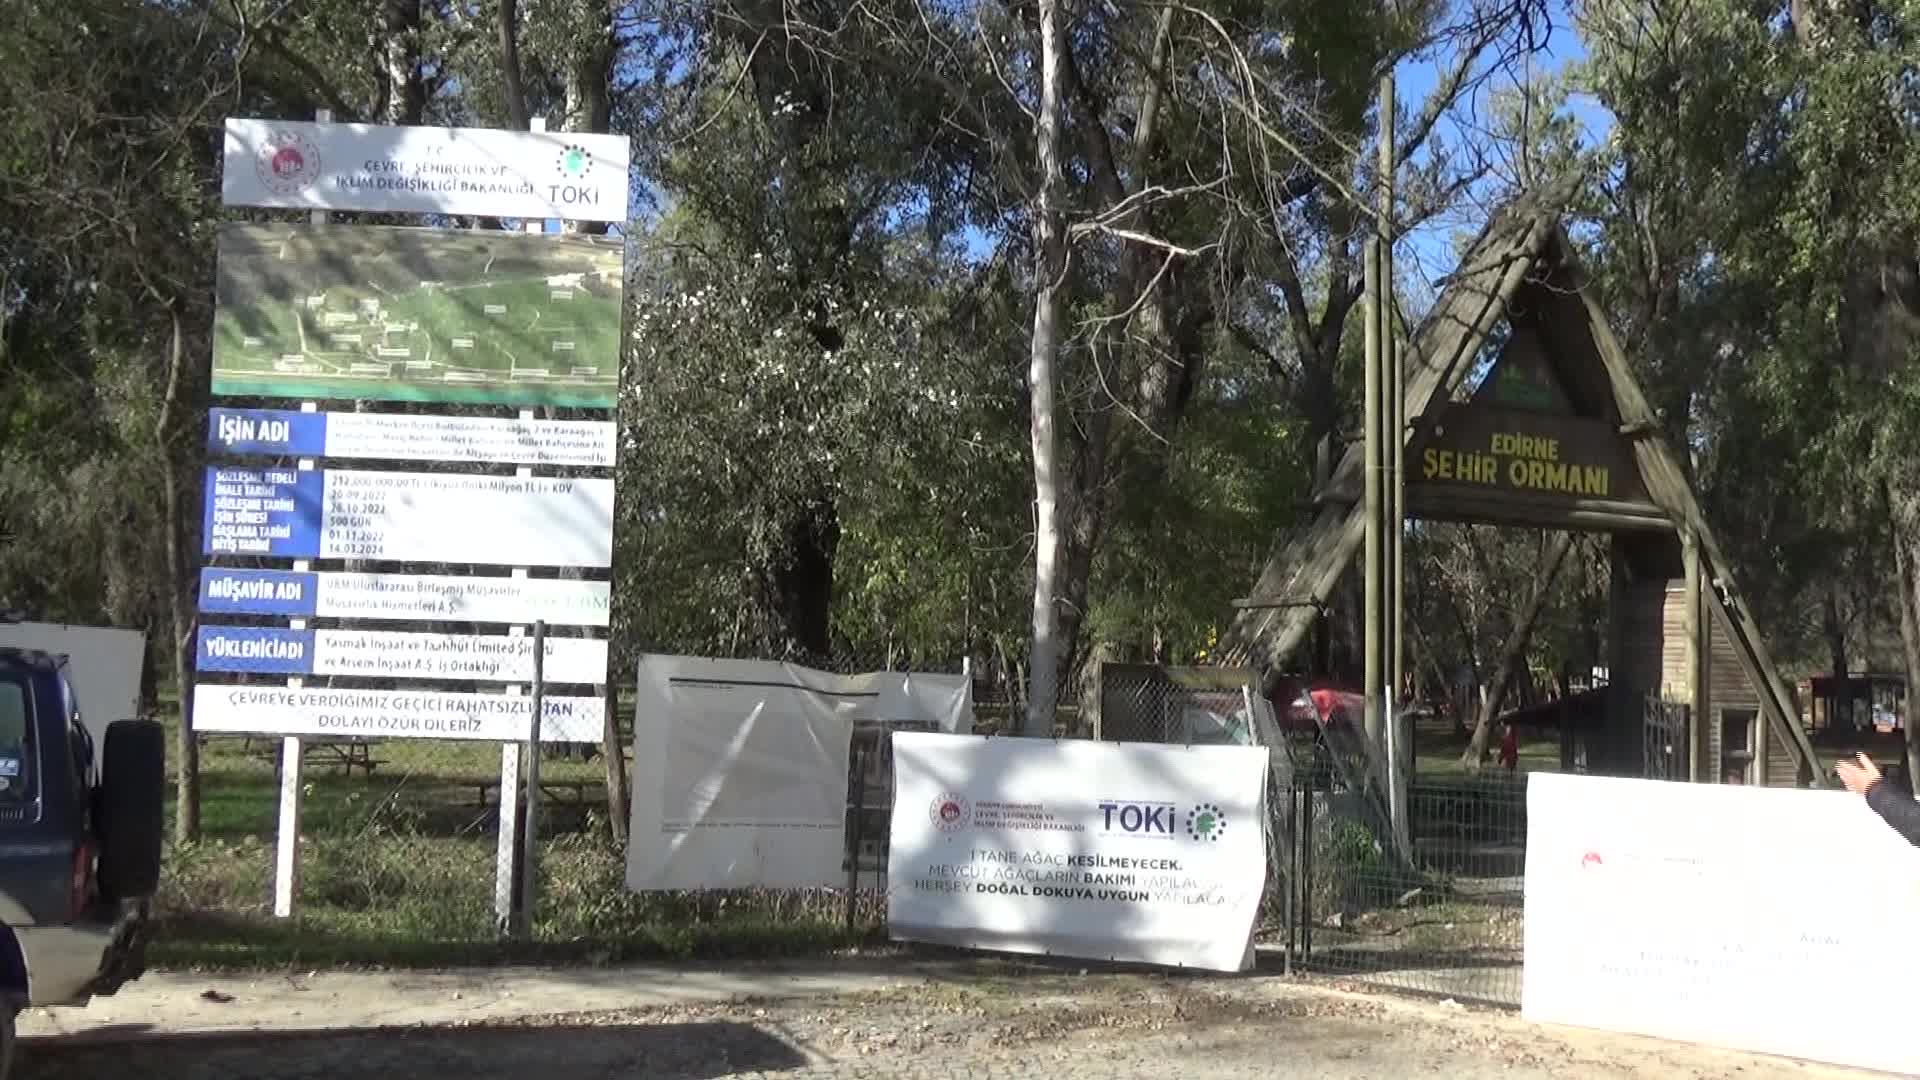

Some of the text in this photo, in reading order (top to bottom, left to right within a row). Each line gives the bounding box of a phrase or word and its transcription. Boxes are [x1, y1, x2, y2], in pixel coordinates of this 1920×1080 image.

[336, 175, 535, 195] İKLİM DEĞİŞİKLİĞİ BAKANLIĞI
[218, 414, 290, 445] İŞİN ADI
[517, 437, 543, 447] Millet
[1490, 431, 1560, 460] EDİRNE
[1422, 447, 1609, 496] ŞEHİR ORMANI
[552, 484, 574, 494] KDV
[263, 498, 295, 512] TARİHİ
[259, 523, 291, 538] TARİHİ
[330, 516, 349, 527] 500
[329, 543, 385, 554] 14.03.2024
[207, 576, 302, 601] MÜŞAVİR ADI
[228, 689, 573, 716] ÇEVREYE VERDİĞİMİZ GEÇİCİ RAHATSIZLITAN
[318, 714, 375, 729] DOLAYI
[423, 716, 483, 733] DİLERİZ
[1043, 823, 1086, 833] BAKANLIĞI
[1098, 803, 1176, 834] TOKİ
[978, 849, 1018, 864] TANE
[1066, 852, 1184, 871] KESİLMEYECEK.
[928, 863, 991, 880] MEVCUT
[993, 867, 1081, 884] AĞAÇLARIN
[1083, 872, 1136, 886] BAKIMI
[975, 880, 1029, 897] DOĞAL
[1031, 884, 1094, 901] DOKUYA
[1097, 888, 1149, 903] UYGUN
